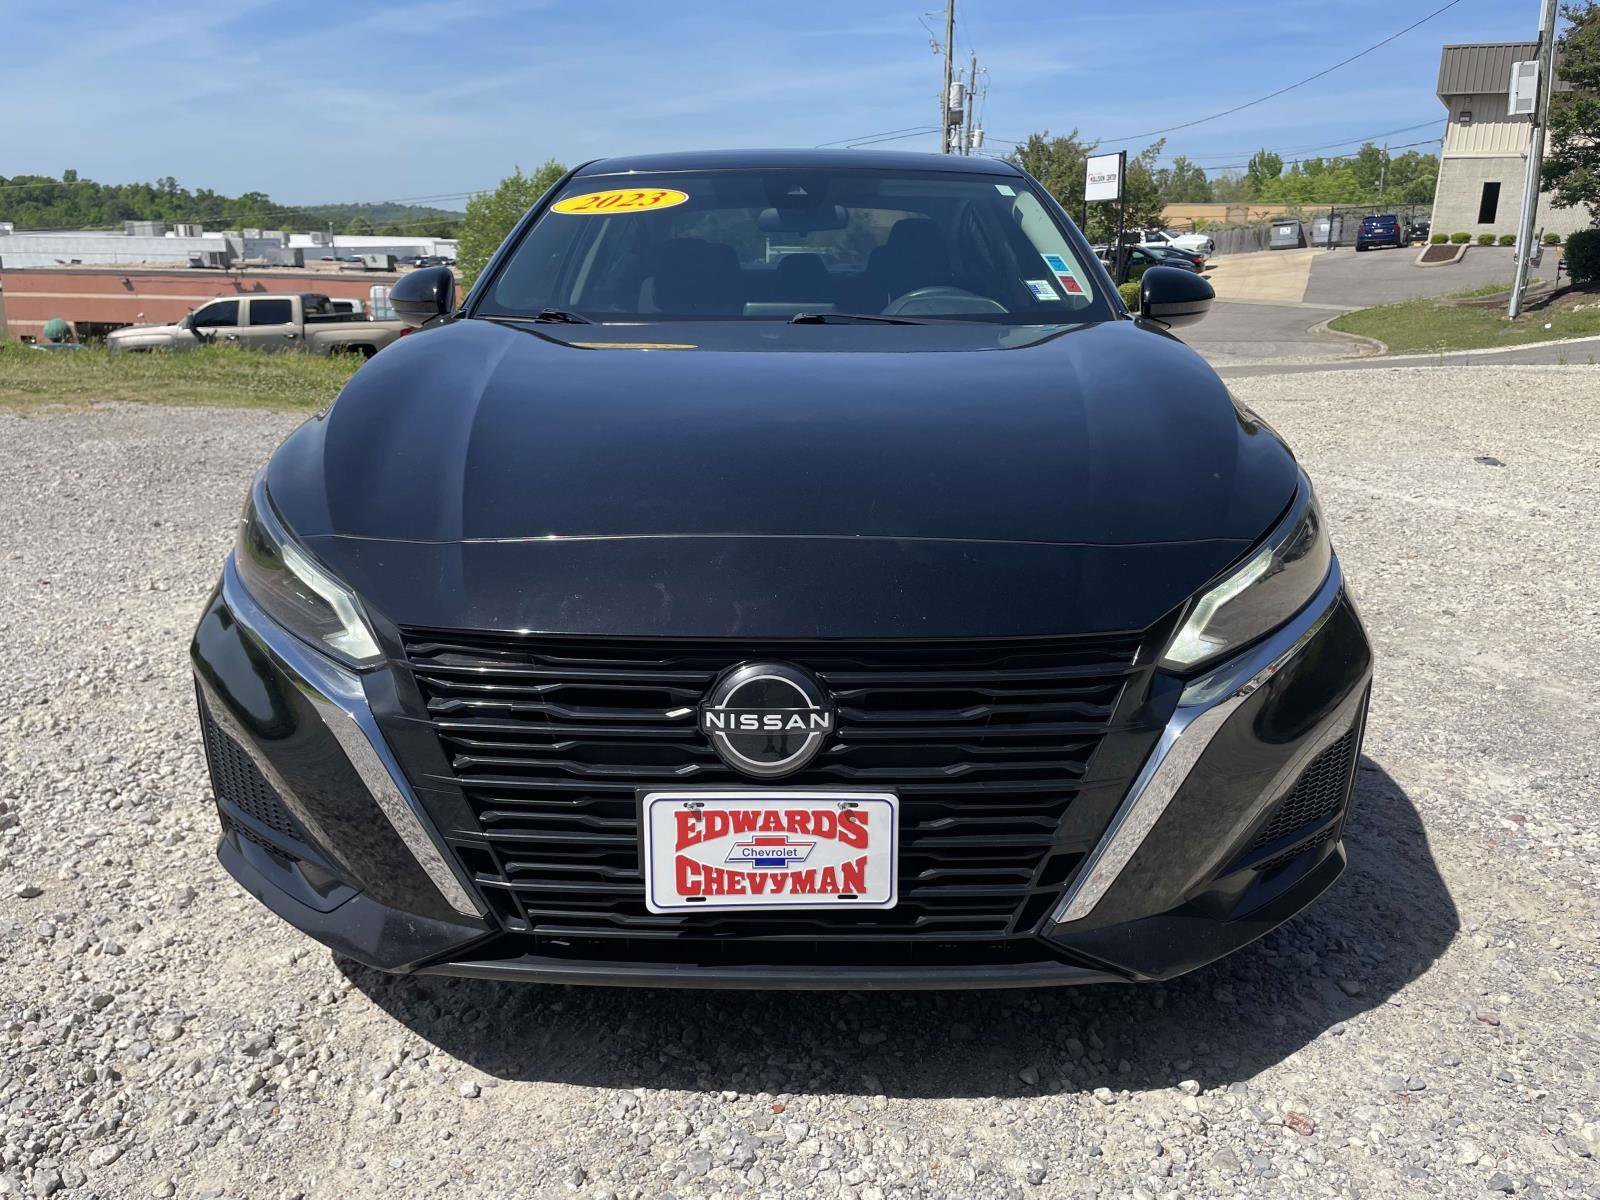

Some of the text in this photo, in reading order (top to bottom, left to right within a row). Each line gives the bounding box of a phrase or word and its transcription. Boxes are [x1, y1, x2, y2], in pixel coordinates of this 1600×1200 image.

[570, 191, 667, 211] 2023
[705, 711, 829, 730] NISSAN
[674, 809, 869, 853] EDWARDS
[742, 848, 798, 857] Chevrolet
[675, 854, 868, 896] CHEVYMAN
